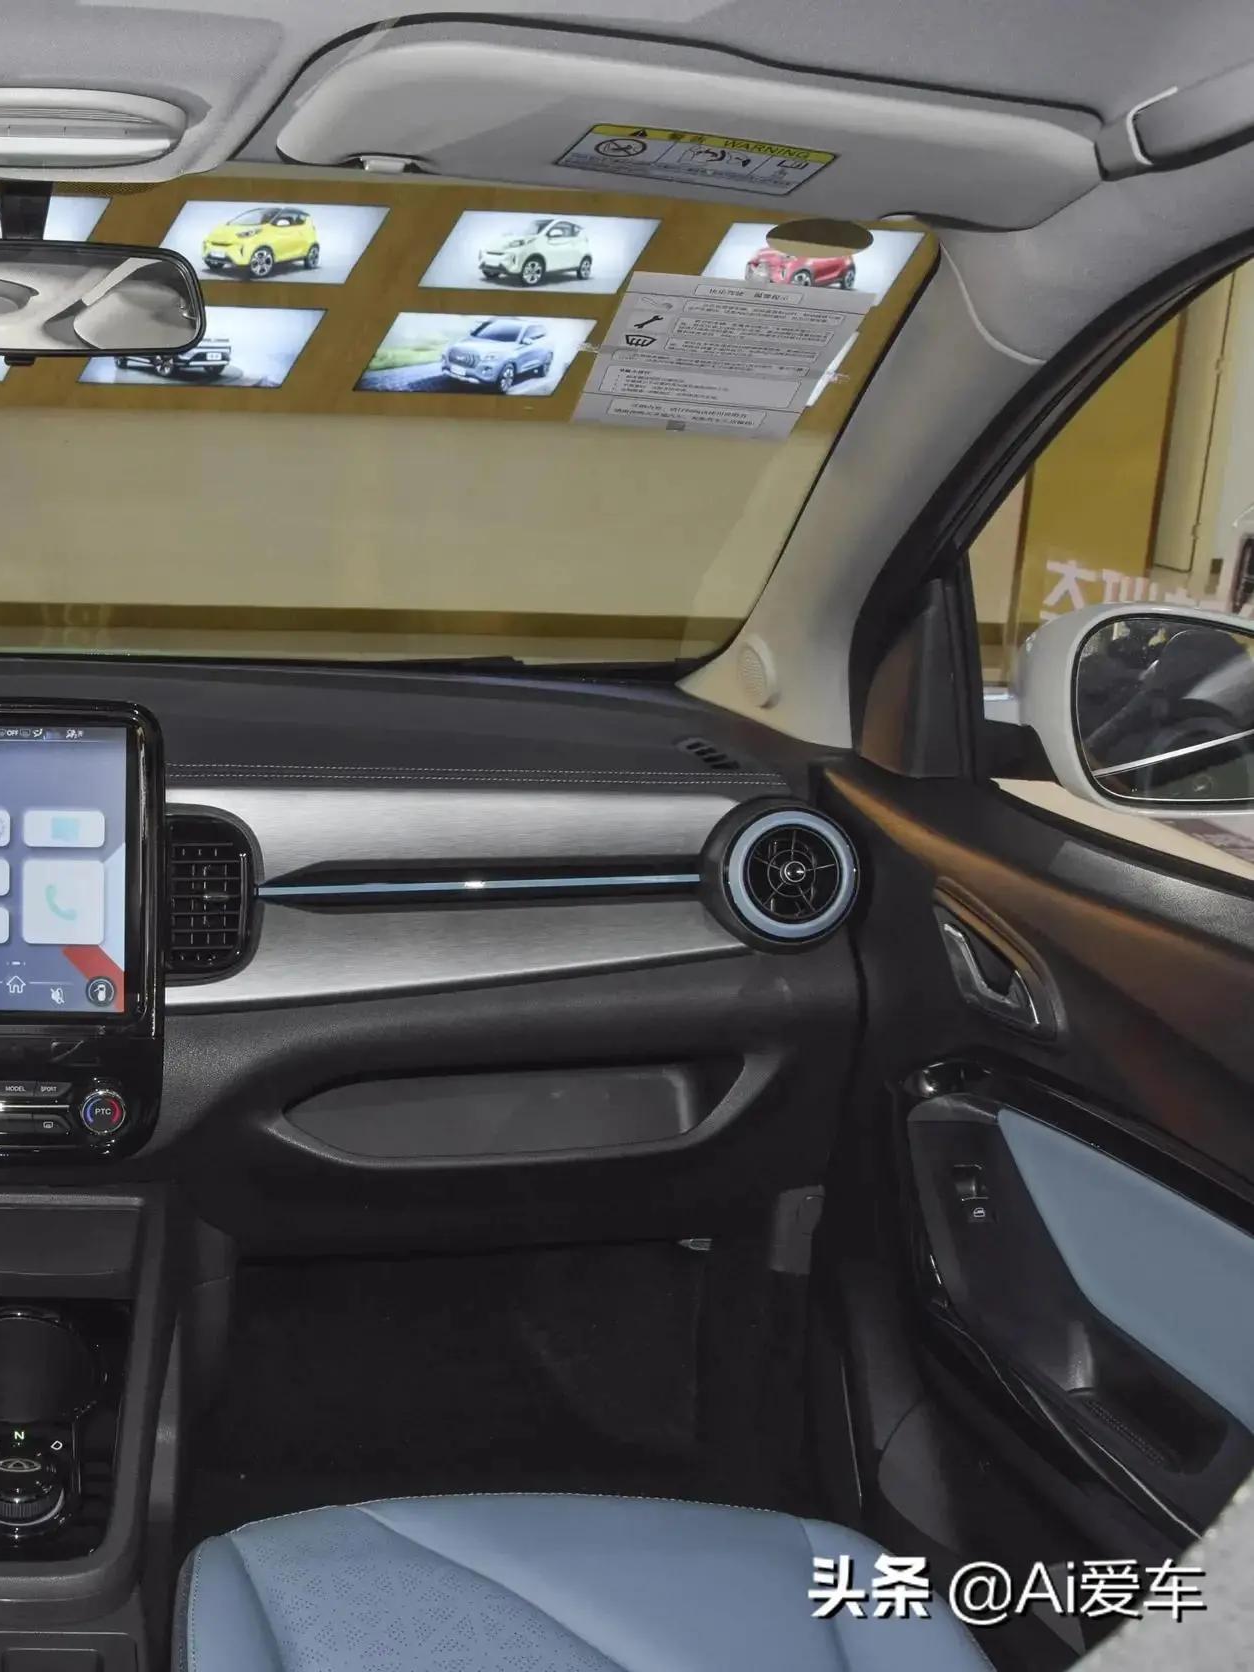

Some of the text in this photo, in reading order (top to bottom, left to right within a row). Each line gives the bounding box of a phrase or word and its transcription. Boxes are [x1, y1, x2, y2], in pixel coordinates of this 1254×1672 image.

[94, 1108, 112, 1116] PTC
[14, 1431, 25, 1440] N
[50, 1440, 63, 1451] D
